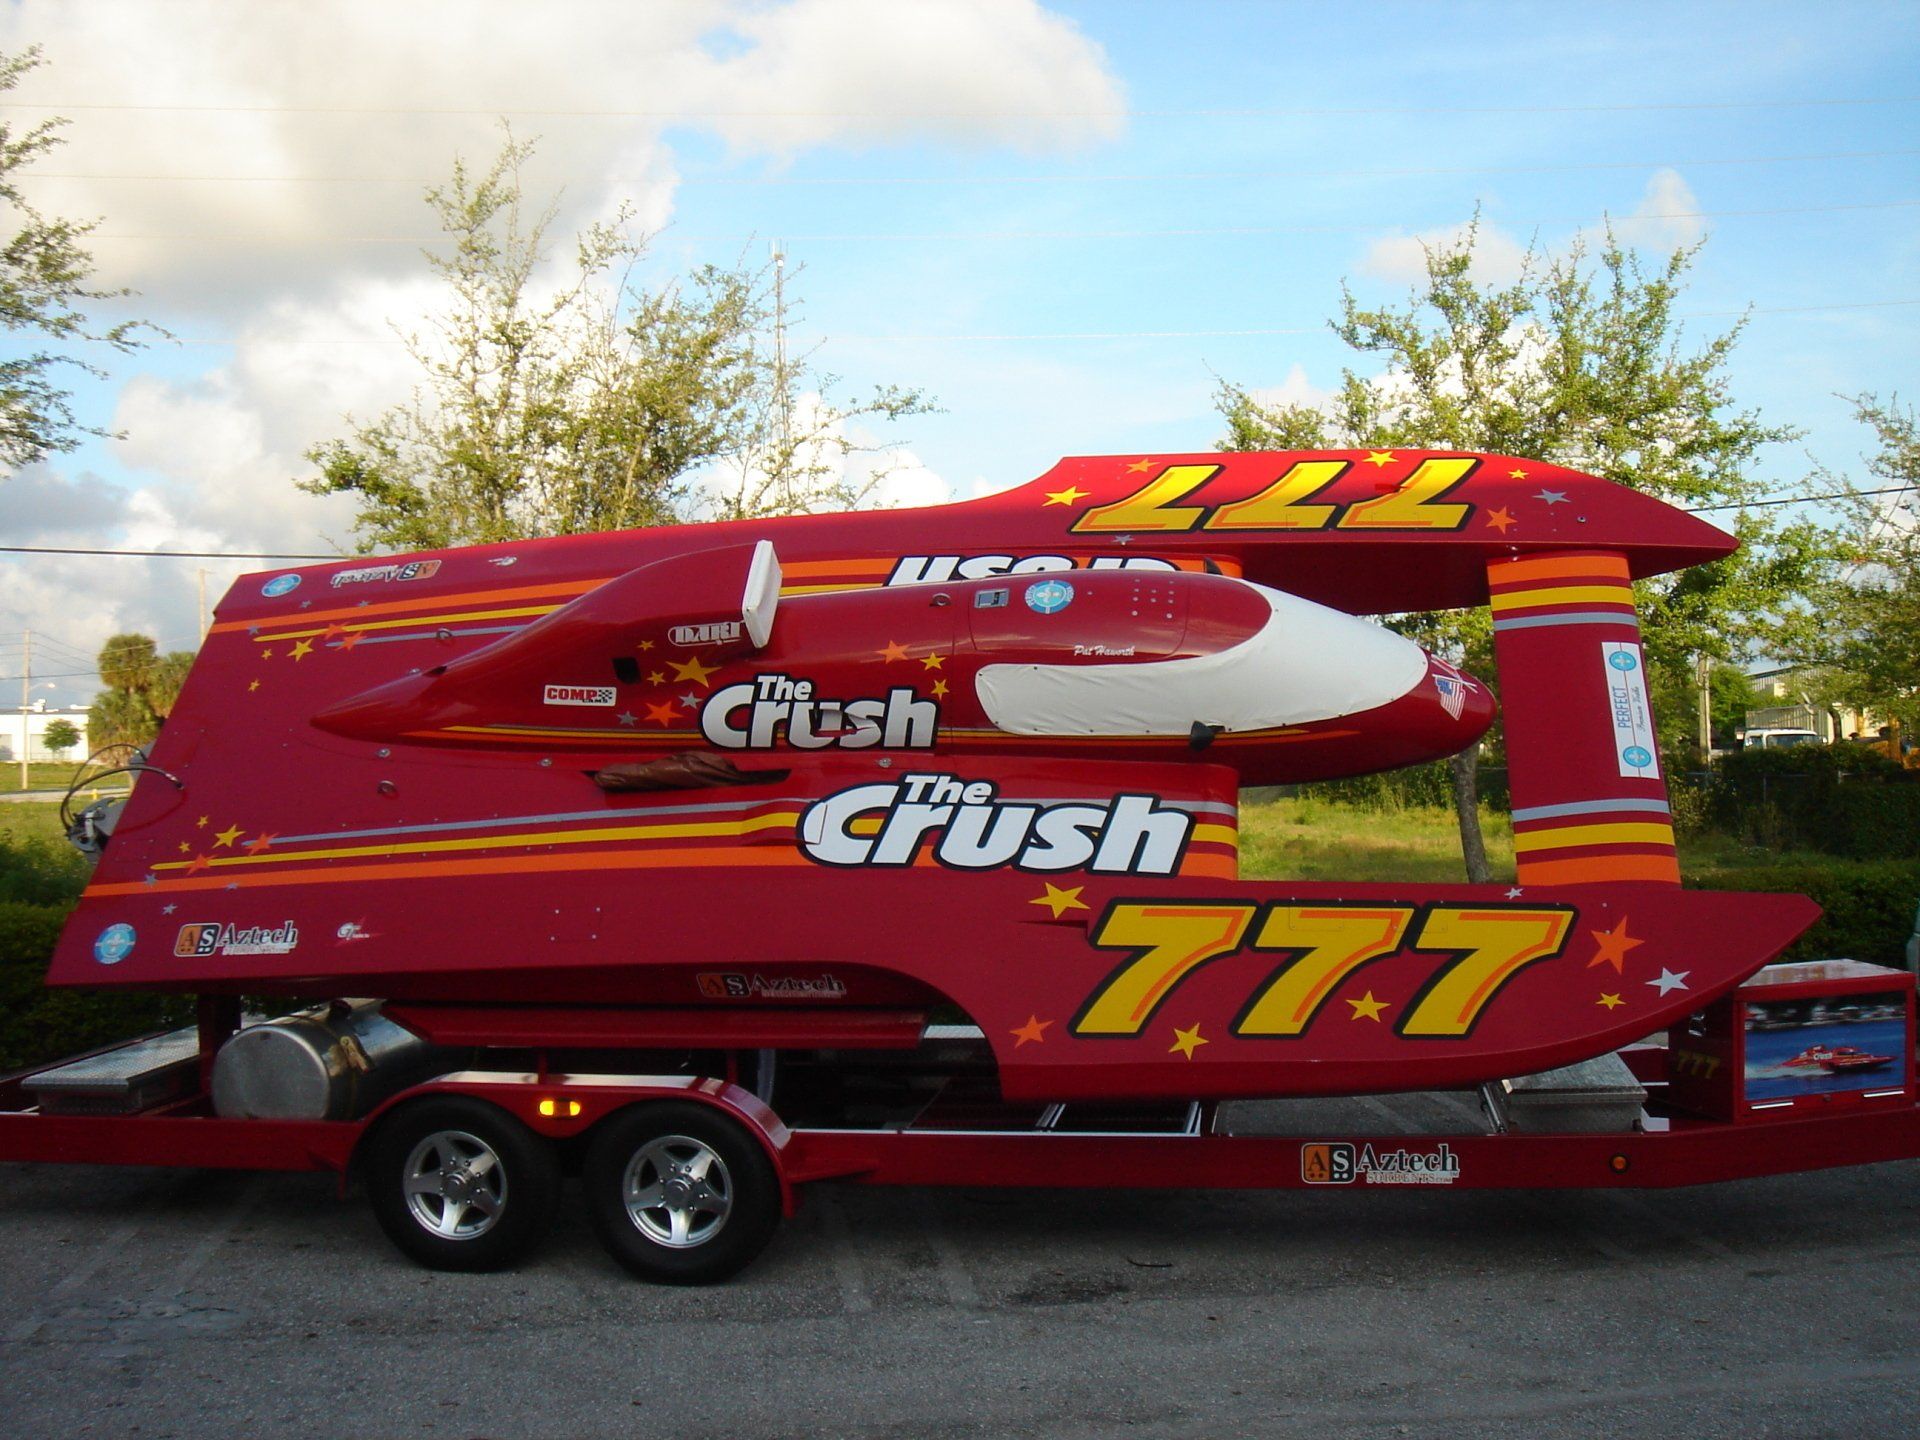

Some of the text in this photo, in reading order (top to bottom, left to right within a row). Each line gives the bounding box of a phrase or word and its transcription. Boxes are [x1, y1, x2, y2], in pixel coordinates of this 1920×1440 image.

[546, 687, 598, 700] COMP
[757, 675, 812, 700] The
[702, 685, 937, 748] Crush
[1612, 686, 1631, 728] PERFECT
[904, 774, 992, 804] The
[802, 784, 1190, 875] Crush
[218, 921, 298, 947] Aztech
[751, 973, 846, 993] Aztech
[1070, 899, 1578, 1038] 777
[1357, 1142, 1459, 1173] Aztech
